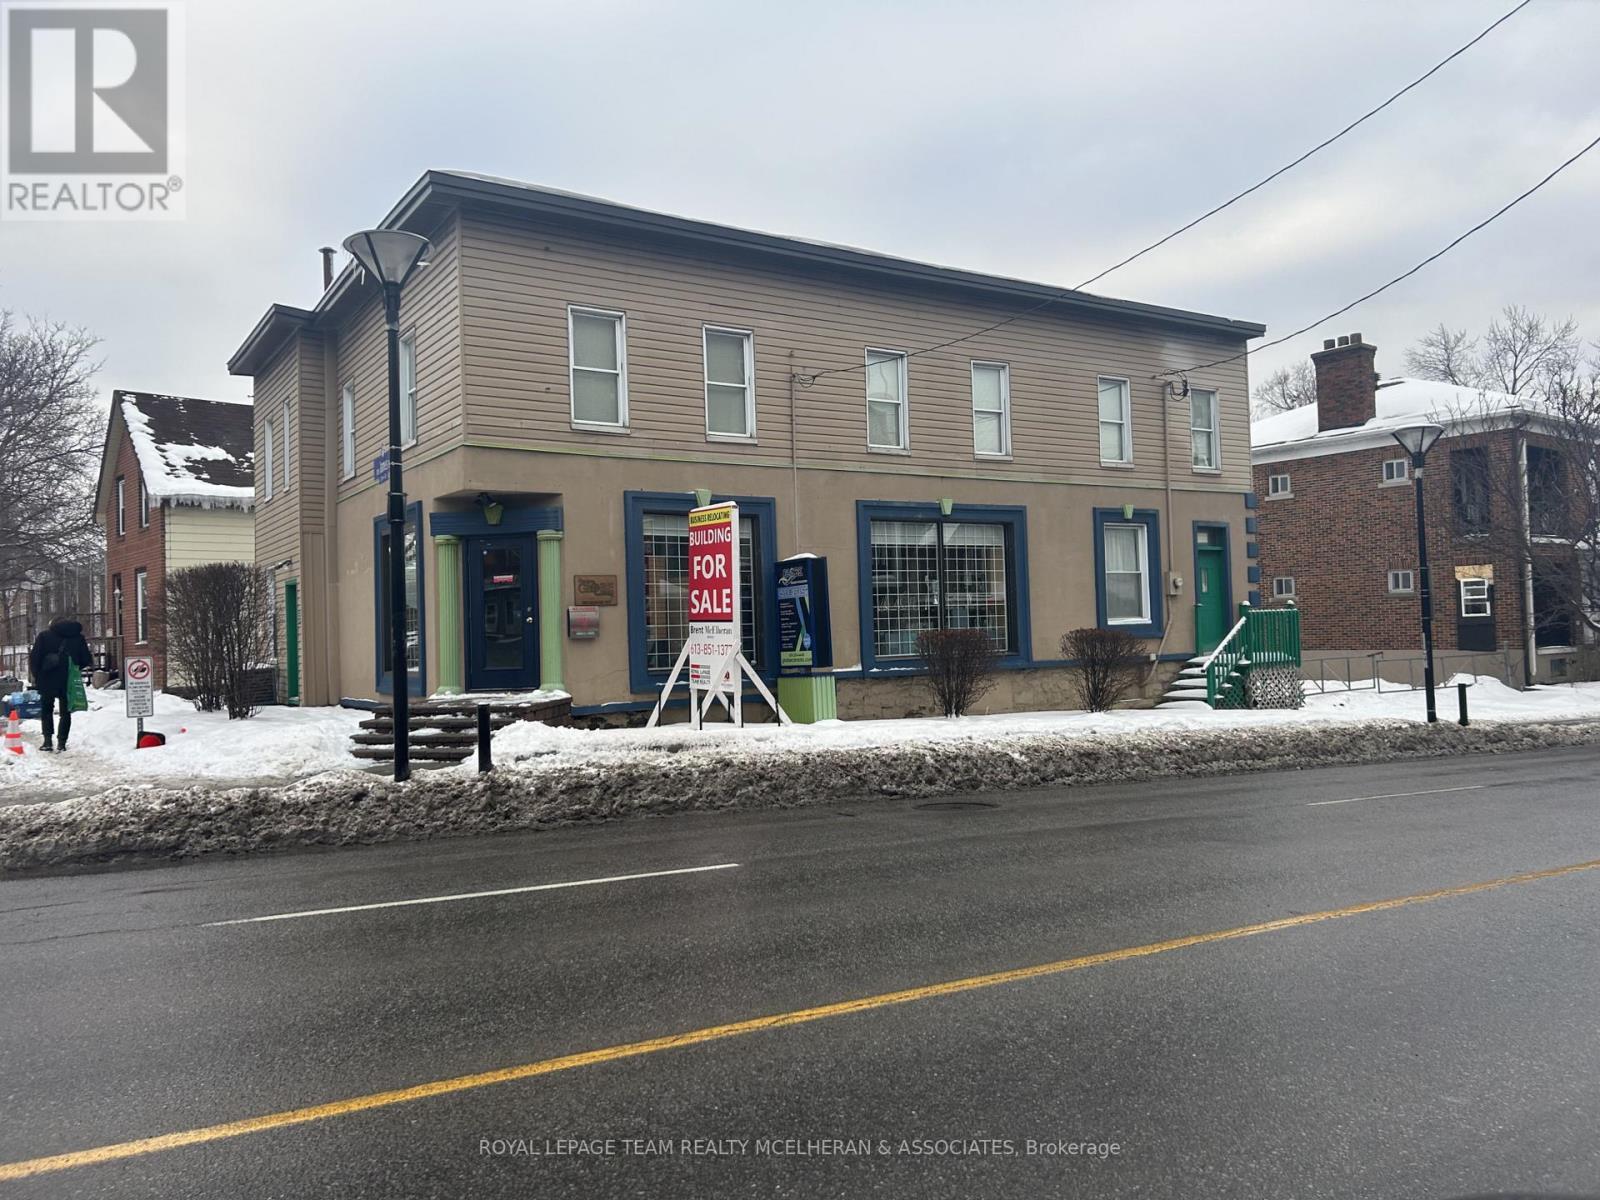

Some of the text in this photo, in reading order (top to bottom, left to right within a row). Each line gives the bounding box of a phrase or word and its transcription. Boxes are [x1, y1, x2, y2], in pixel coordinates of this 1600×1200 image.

[689, 526, 731, 547] BUILDING
[693, 553, 727, 580] FOR
[690, 588, 732, 614] SALE
[690, 625, 704, 634] Brent
